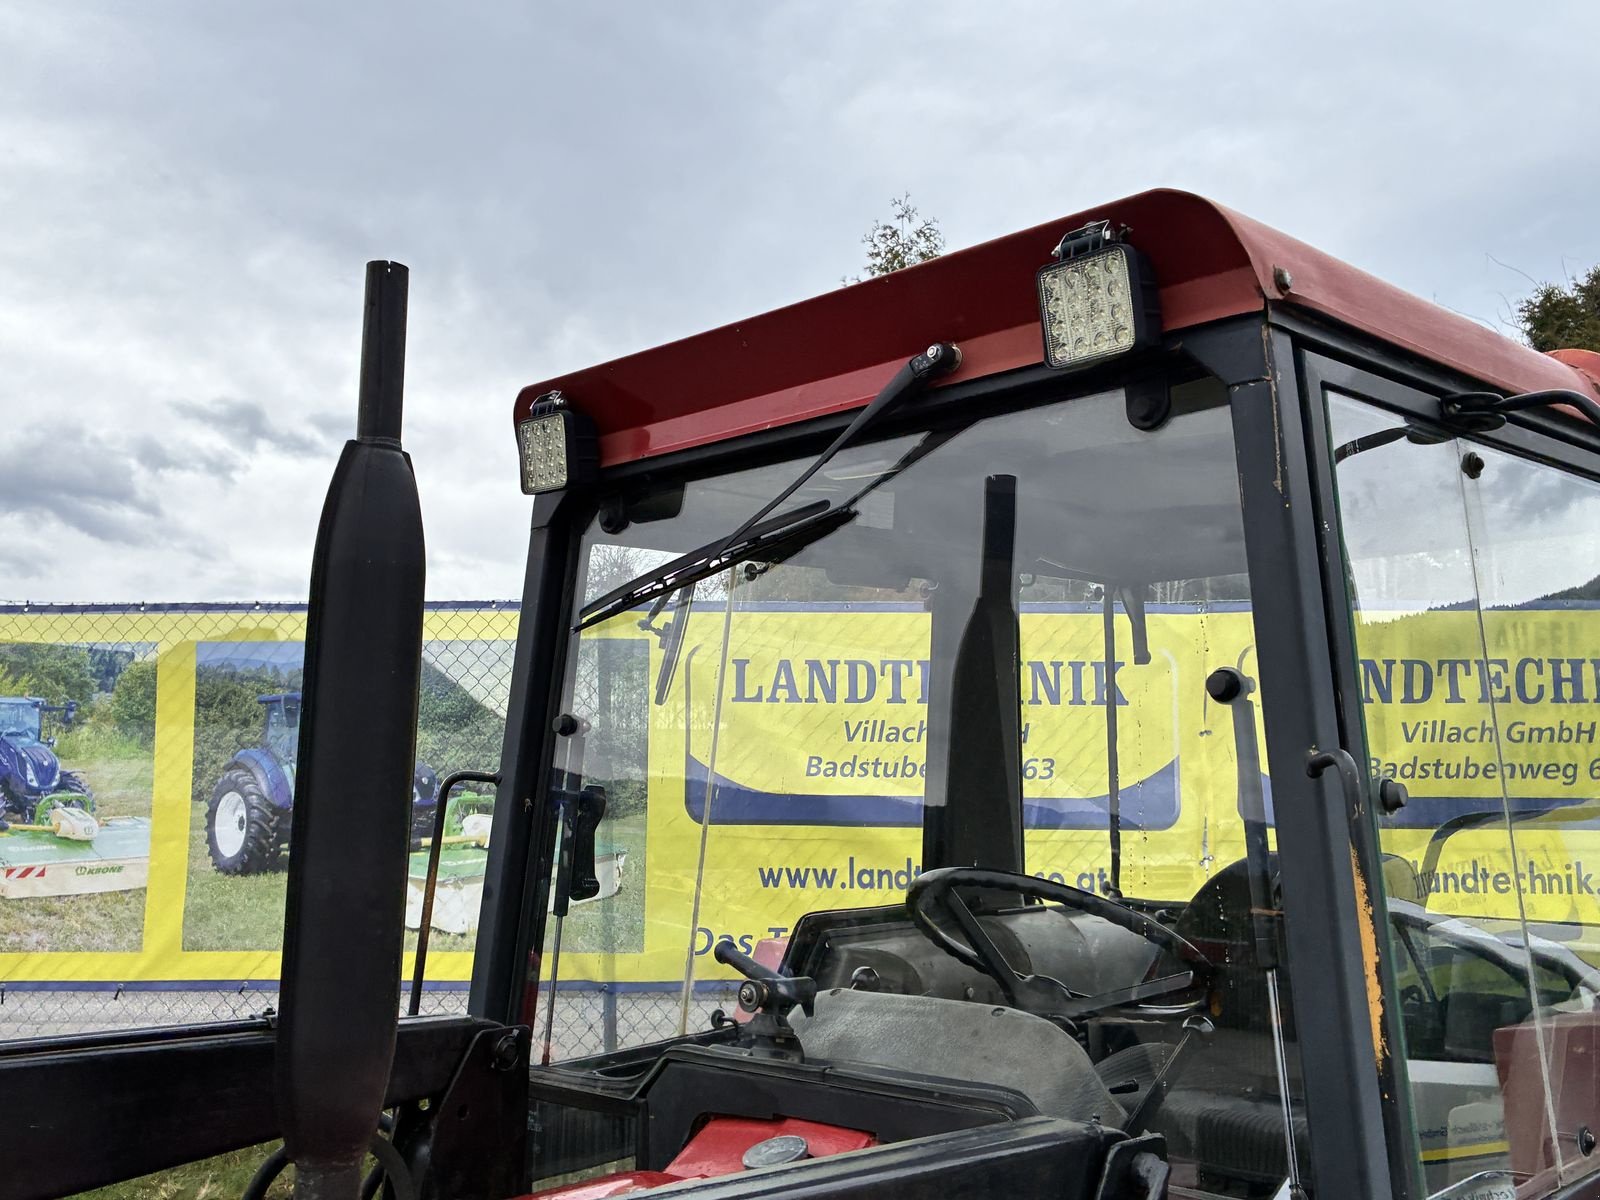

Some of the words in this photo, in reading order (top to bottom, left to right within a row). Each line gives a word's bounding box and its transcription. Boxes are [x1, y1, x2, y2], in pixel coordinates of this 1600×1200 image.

[1359, 657, 1600, 705] NDTECH
[1401, 719, 1496, 744] Villach
[1506, 720, 1596, 744] GmbH
[1022, 757, 1055, 780] 63
[86, 864, 125, 876] KRONE
